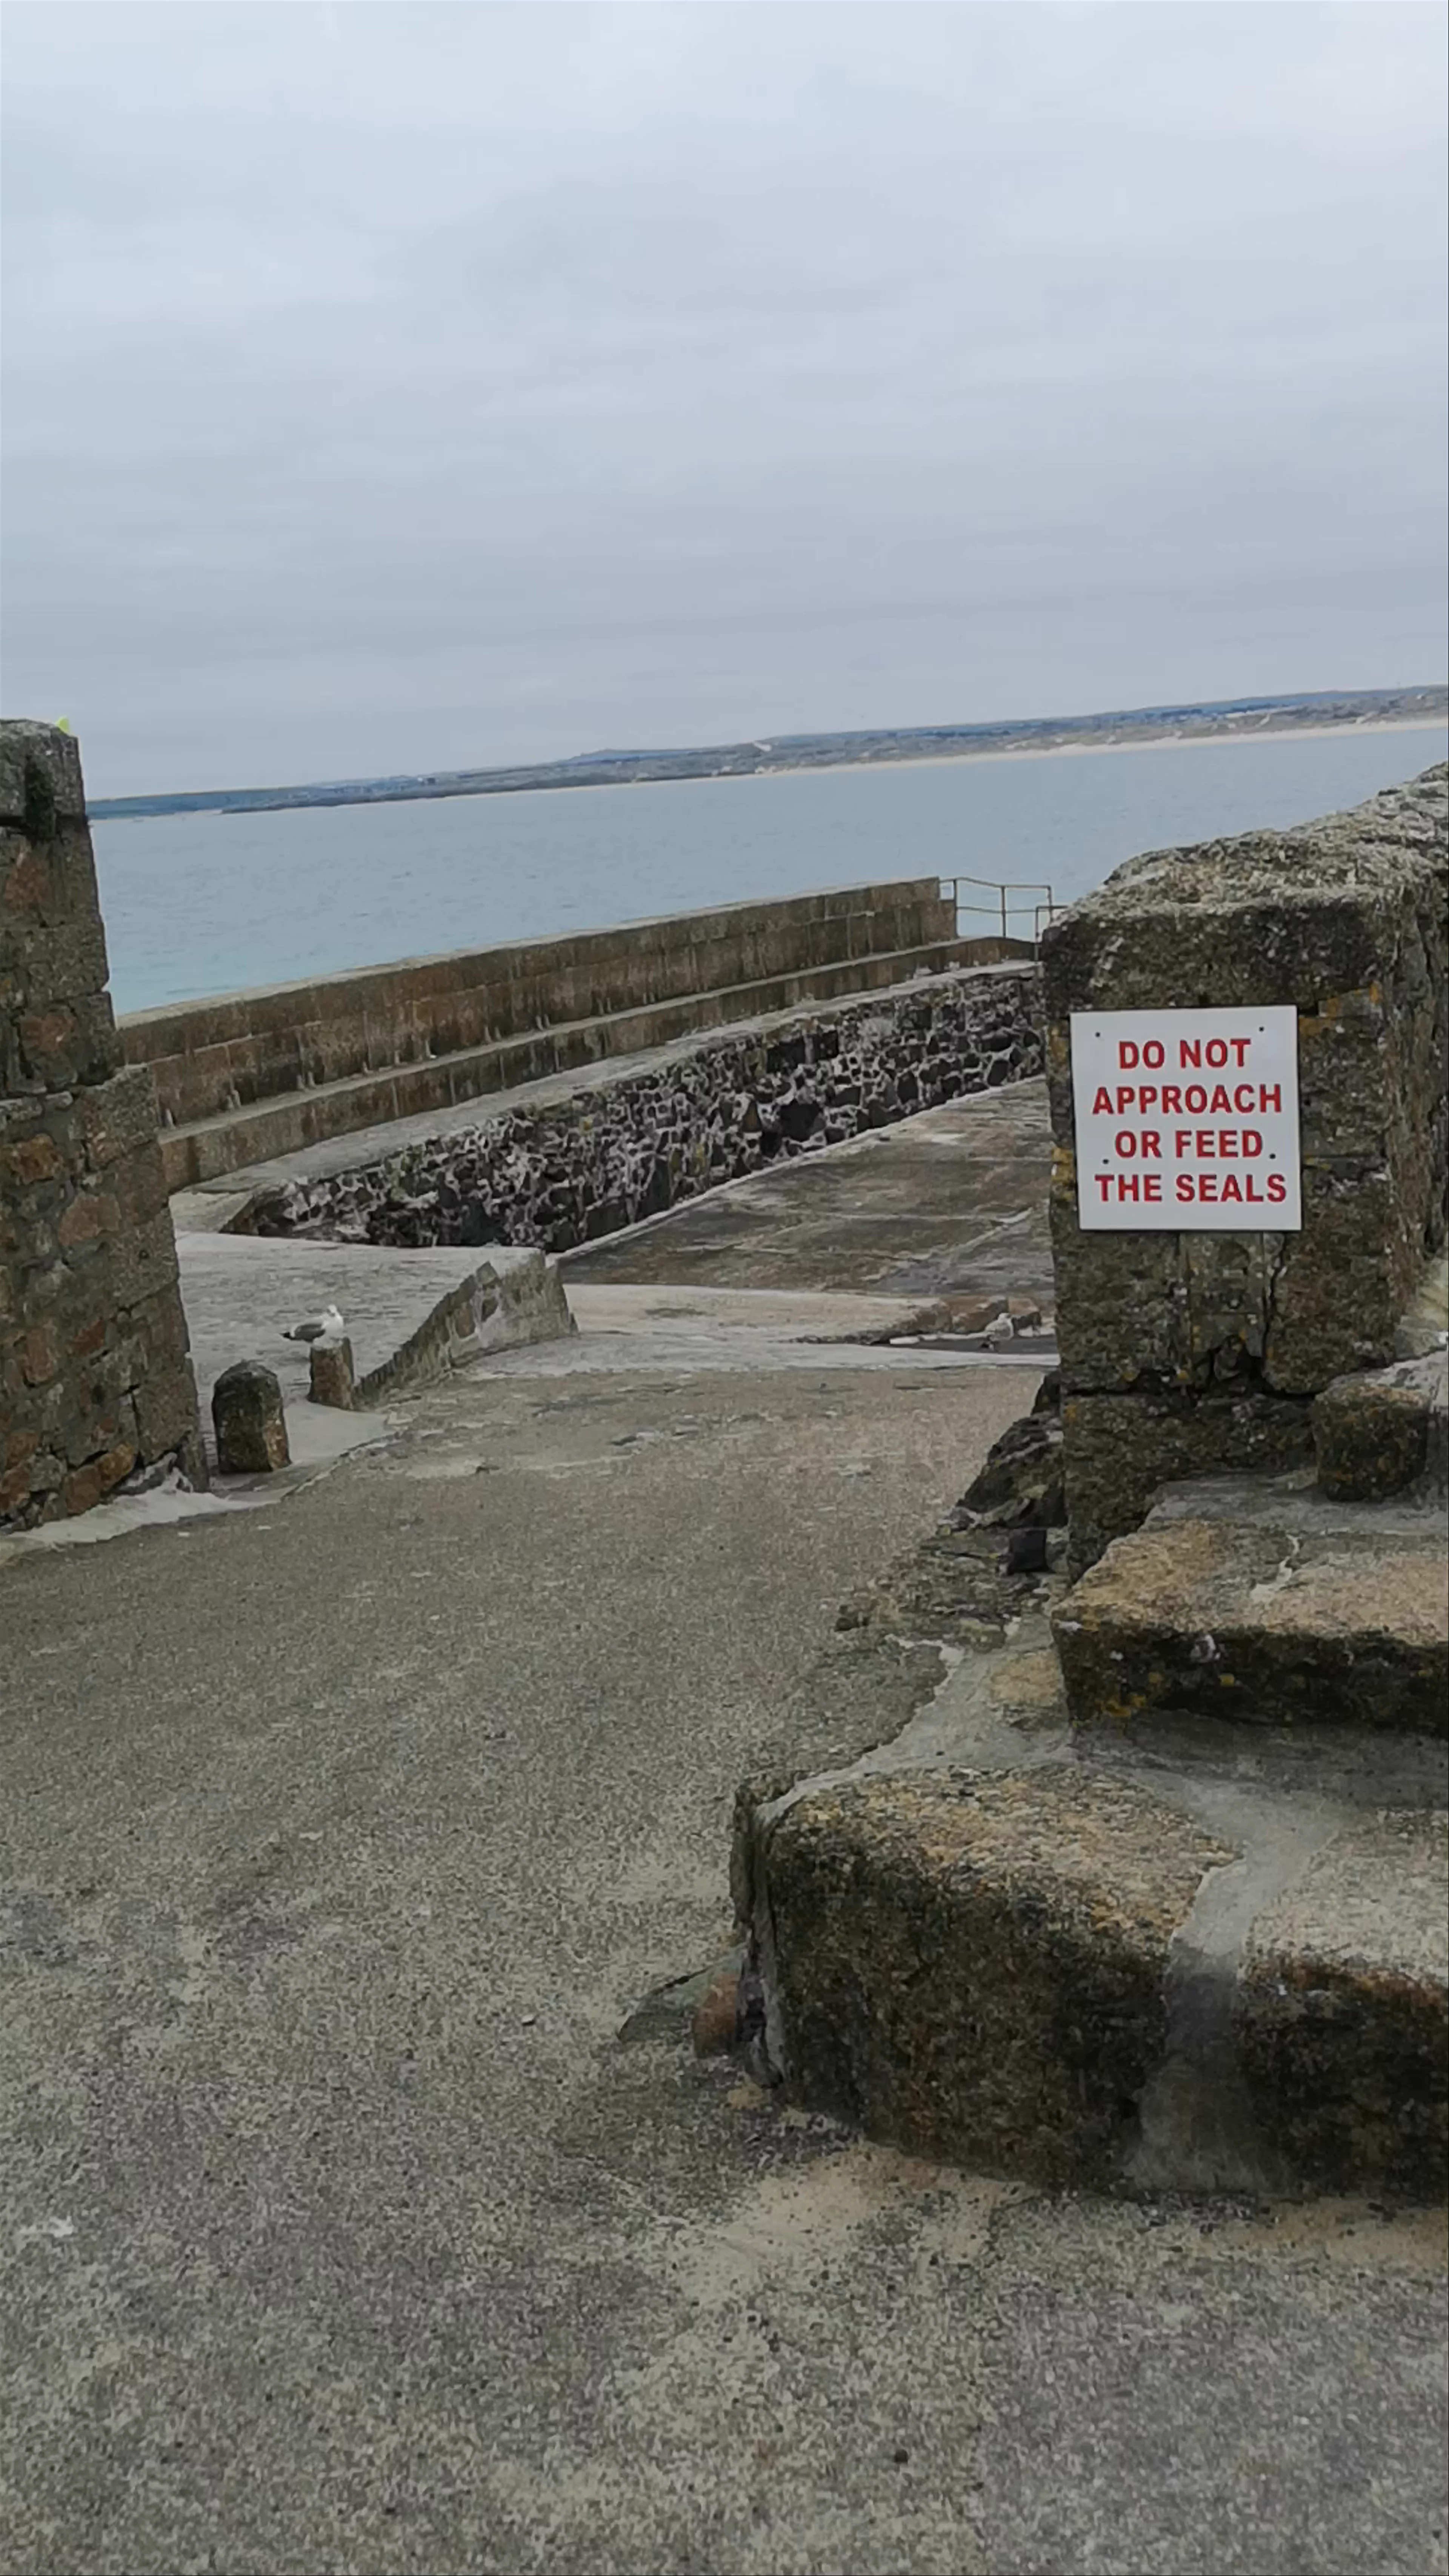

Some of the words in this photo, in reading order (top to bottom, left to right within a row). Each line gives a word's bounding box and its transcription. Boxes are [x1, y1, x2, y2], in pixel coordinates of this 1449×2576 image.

[1118, 1041, 1165, 1070] DO
[1180, 1038, 1251, 1068] NOT
[1093, 1084, 1281, 1114] APPROACH
[1115, 1131, 1161, 1159] OR
[1175, 1130, 1262, 1158] FEED
[1094, 1175, 1161, 1202] THE
[1176, 1174, 1286, 1203] SEALS
